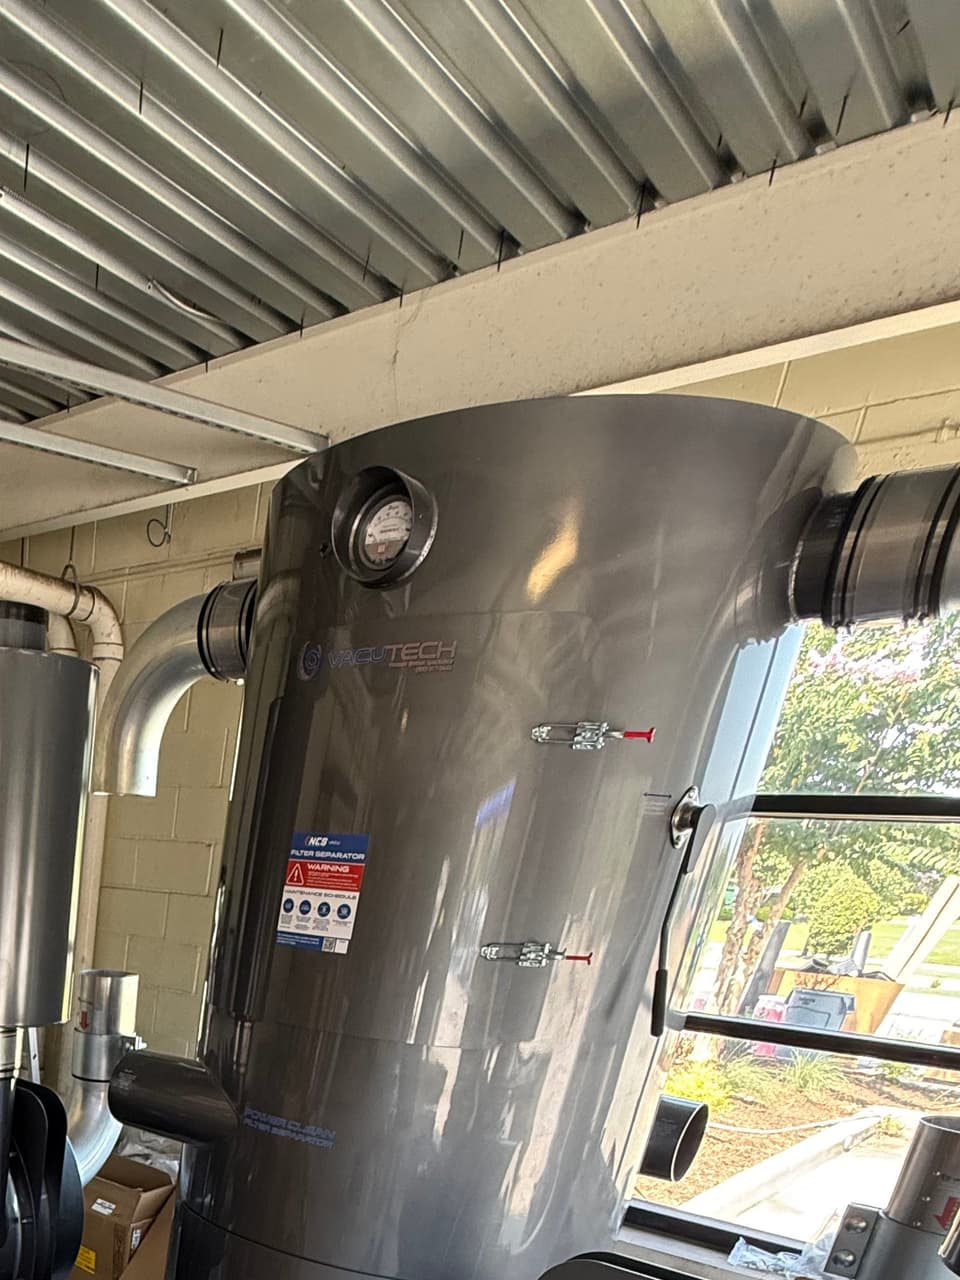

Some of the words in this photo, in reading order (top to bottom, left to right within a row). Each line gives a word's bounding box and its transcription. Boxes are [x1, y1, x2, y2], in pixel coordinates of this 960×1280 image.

[328, 640, 458, 668] VACUTECH
[290, 849, 314, 857] FILTER
[315, 851, 366, 860] SEPARATOR
[307, 863, 350, 873] WARNING
